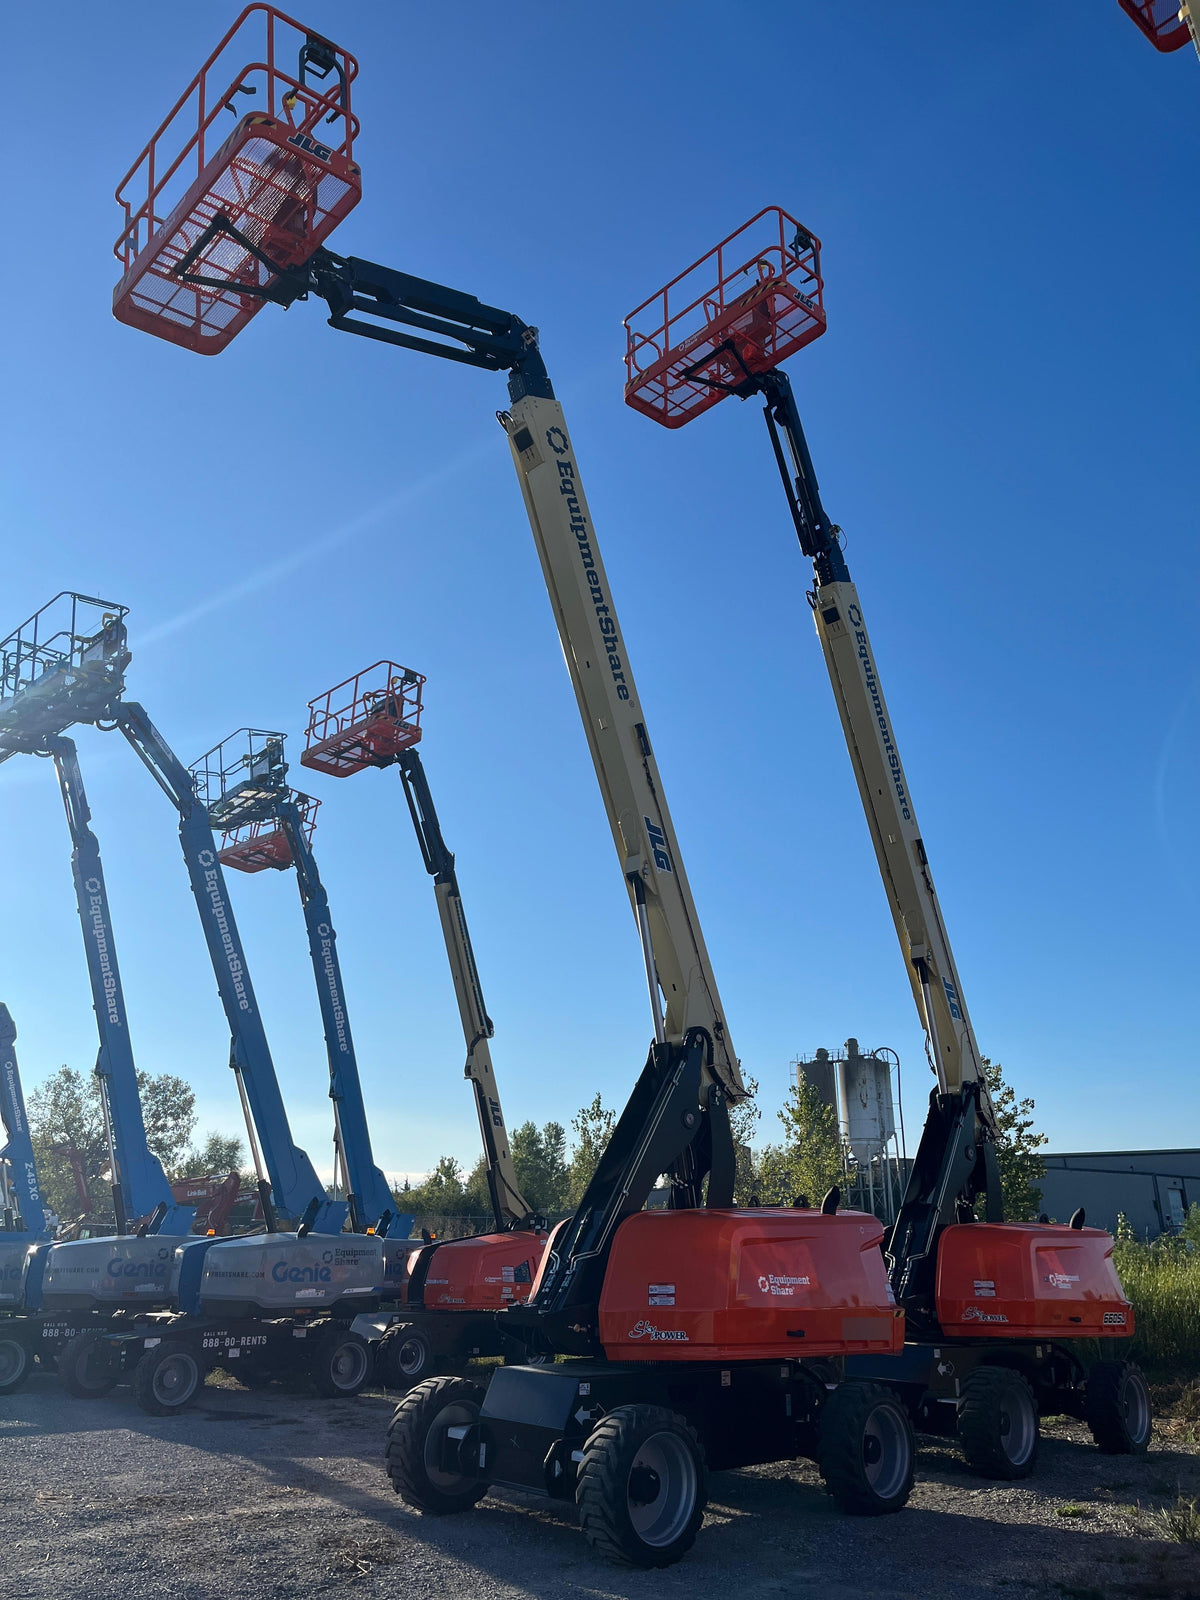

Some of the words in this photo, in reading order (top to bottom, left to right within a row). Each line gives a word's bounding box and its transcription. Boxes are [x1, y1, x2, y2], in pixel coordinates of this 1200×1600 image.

[287, 132, 333, 163] JLG
[793, 291, 814, 310] JLG
[556, 459, 630, 702] EquipmentShare
[854, 630, 911, 821] EquipmentShare
[643, 816, 672, 873] JLG
[204, 869, 249, 1010] EquipmentShare
[89, 895, 119, 1024] EquipmentShare
[321, 938, 348, 1052] EquipmentShare
[941, 975, 962, 1020] JLG
[7, 1069, 23, 1132] EquipmentShare
[488, 1096, 503, 1127] JLG
[24, 1162, 37, 1185] Z-45
[29, 1186, 39, 1201] XC
[335, 1248, 377, 1258] Equipment
[107, 1257, 167, 1278] Genie
[271, 1261, 332, 1283] Genie
[768, 1274, 811, 1285] Equipment
[770, 1285, 794, 1296] Share
[202, 1335, 268, 1348] 888-80-RENTS
[653, 1330, 687, 1340] POWER
